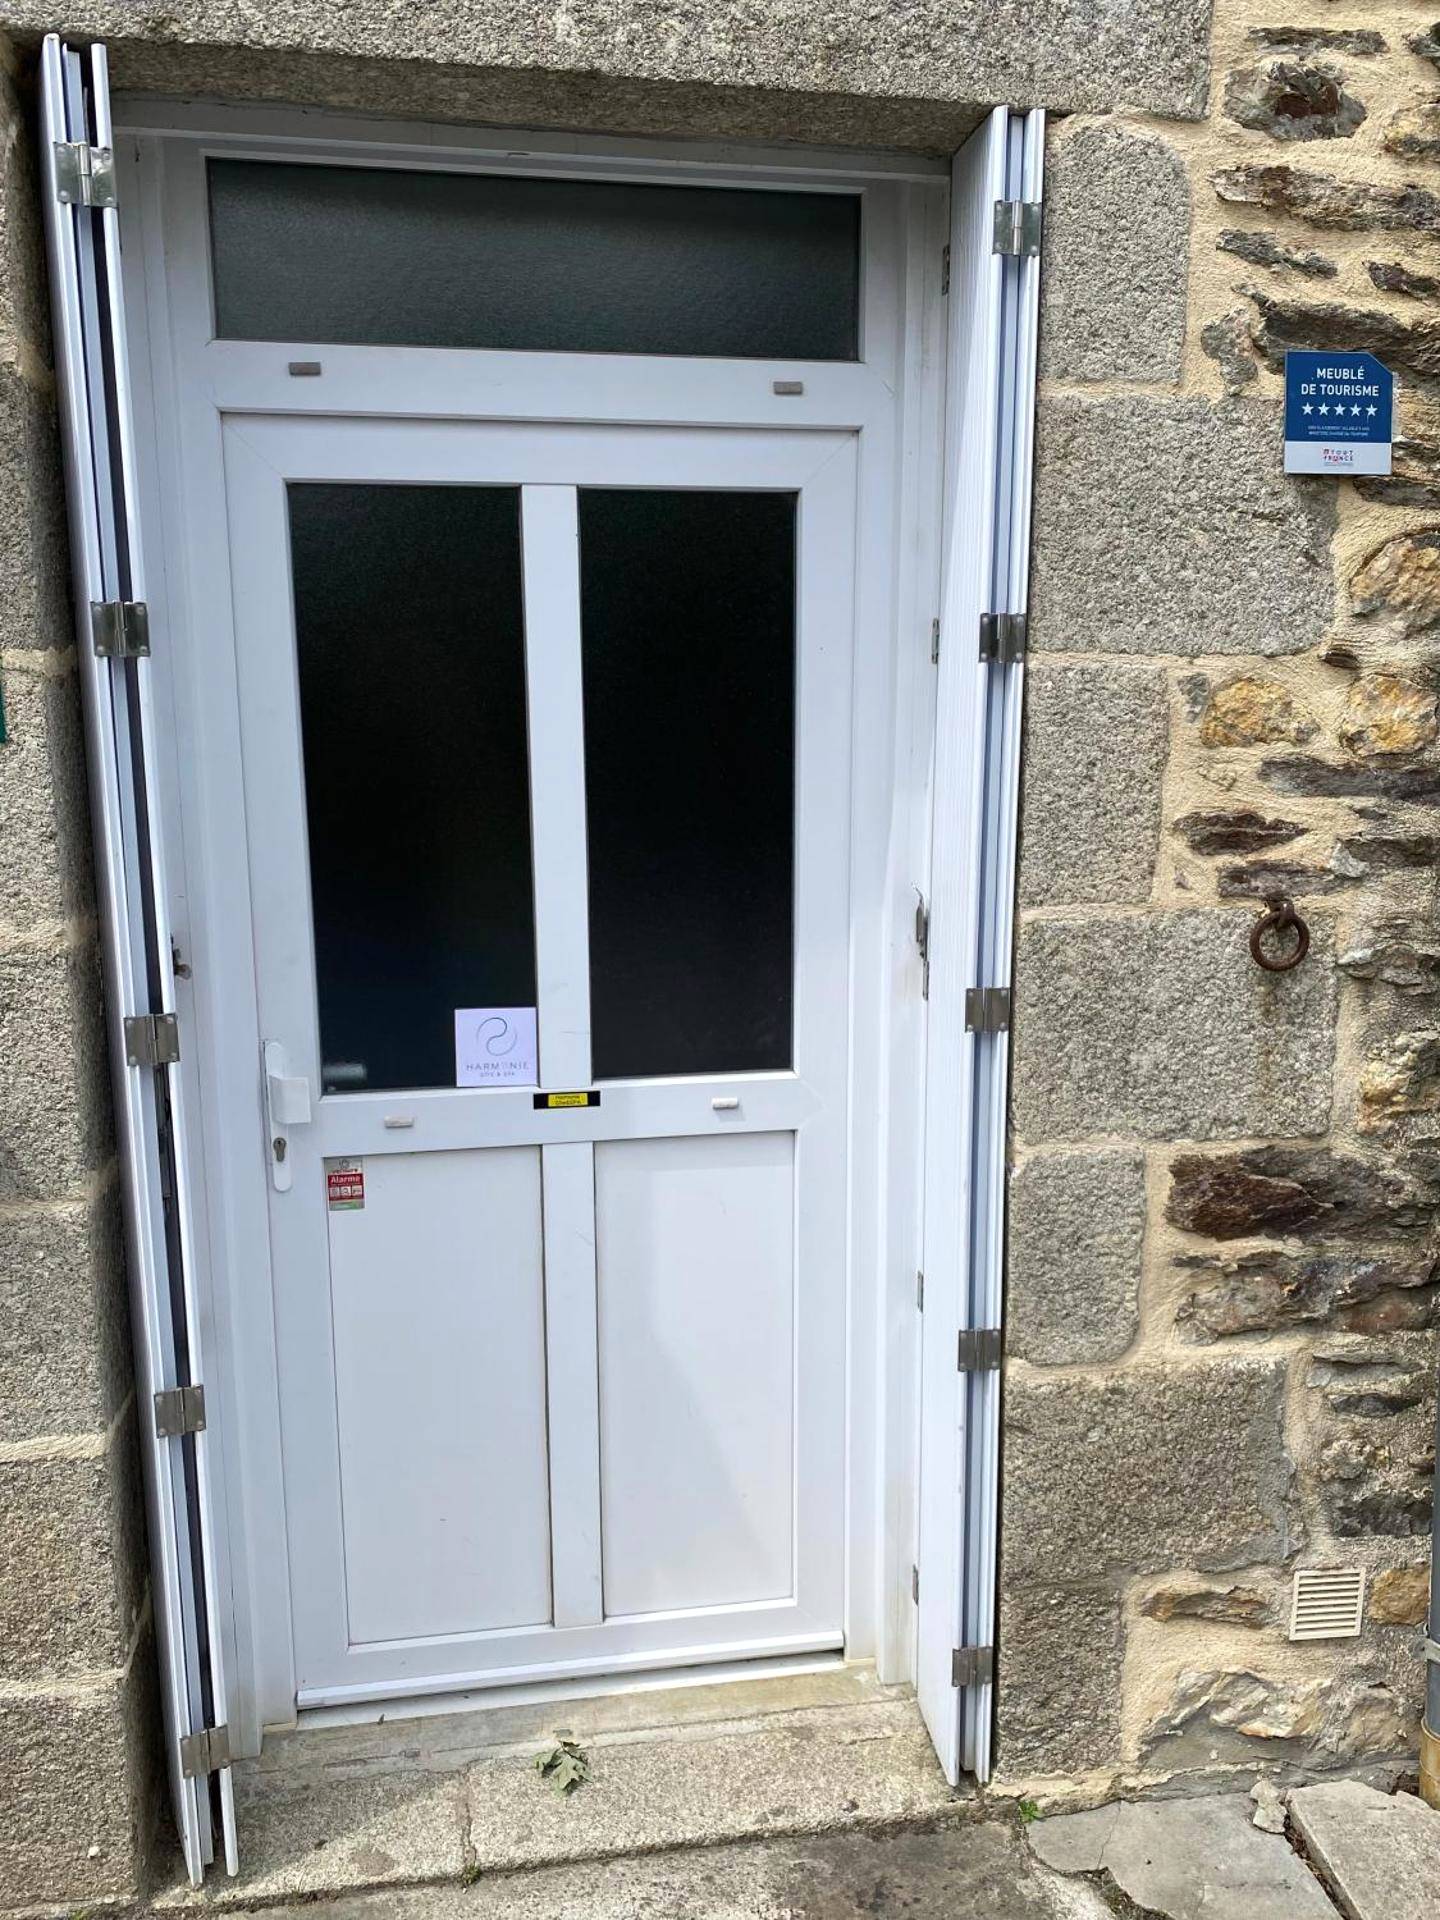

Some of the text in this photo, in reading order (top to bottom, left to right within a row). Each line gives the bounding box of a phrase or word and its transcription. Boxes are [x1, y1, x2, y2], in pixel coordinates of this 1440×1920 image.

[1316, 366, 1365, 380] MEUBLÉ
[1301, 383, 1379, 397] DE TOURISME
